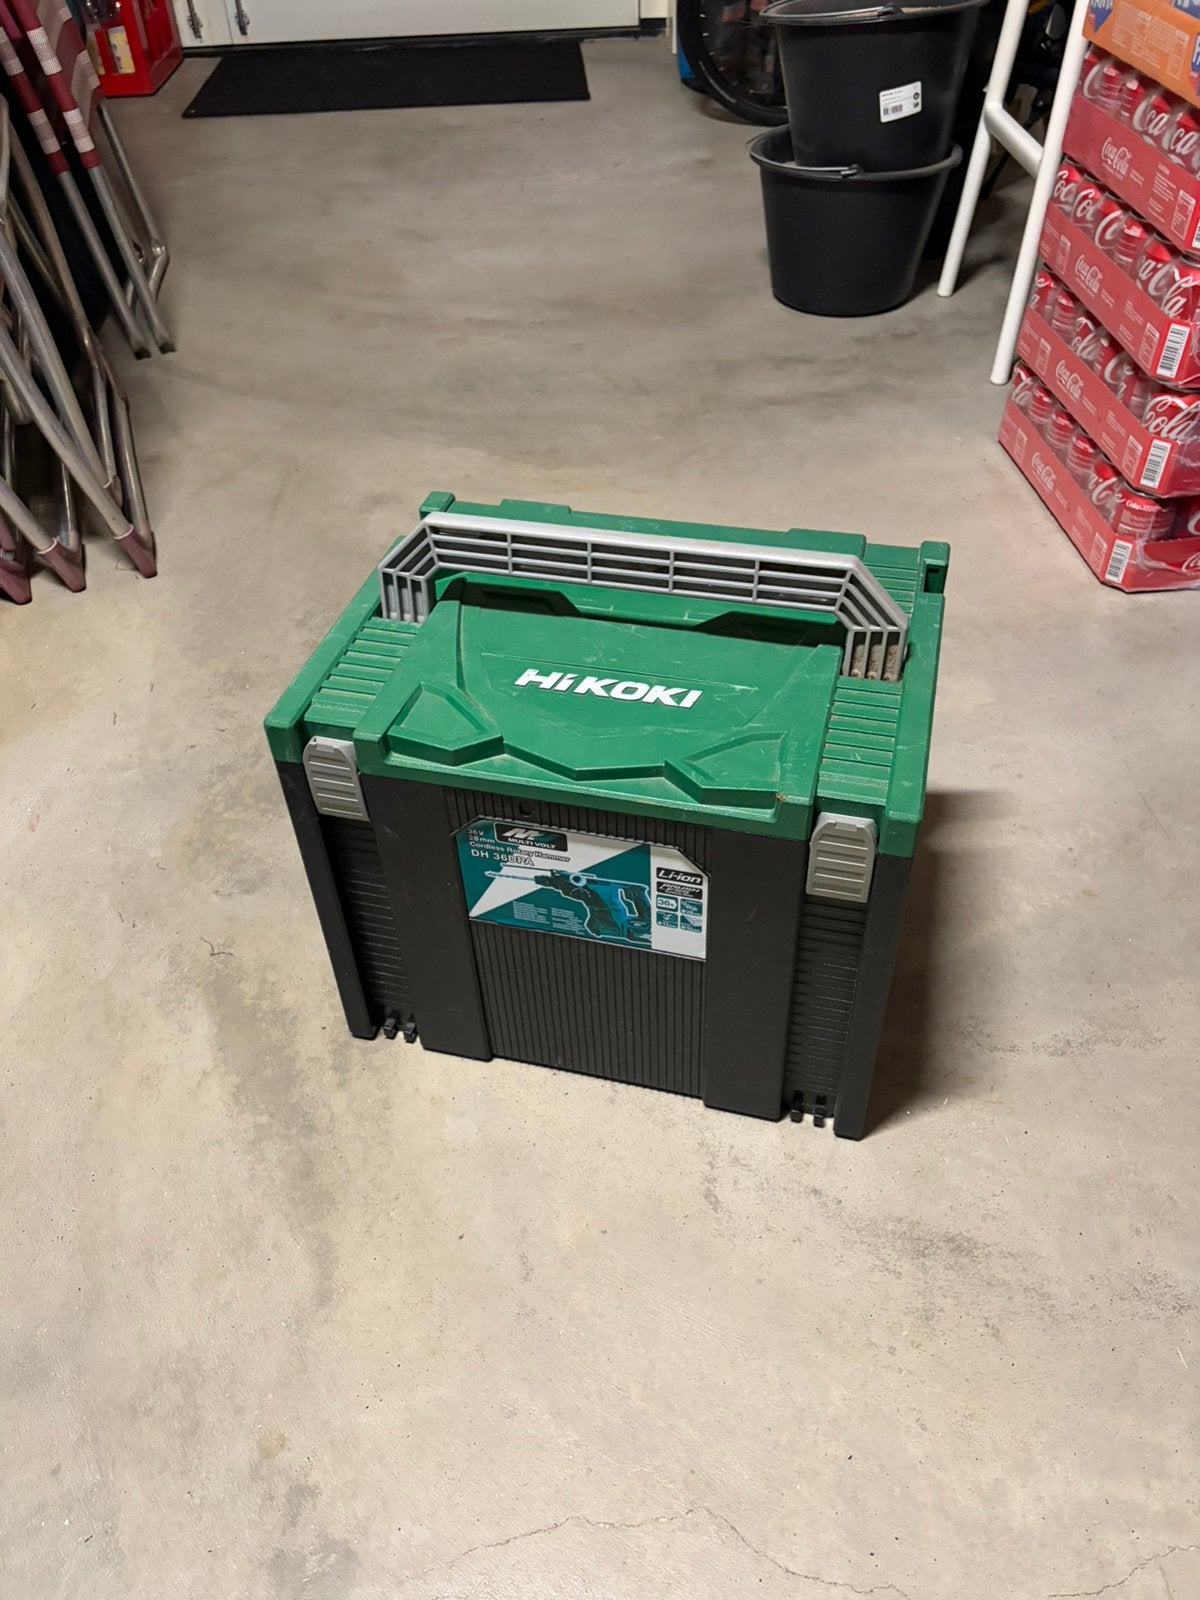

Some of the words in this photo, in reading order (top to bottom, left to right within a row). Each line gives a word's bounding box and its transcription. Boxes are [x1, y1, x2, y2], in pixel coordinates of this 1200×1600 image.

[514, 668, 703, 709] HiKOKI
[469, 841, 505, 852] Cordless
[507, 837, 533, 846] MULTI
[534, 841, 557, 850] VOLT
[471, 848, 489, 859] DH
[658, 869, 701, 884] Li-ion
